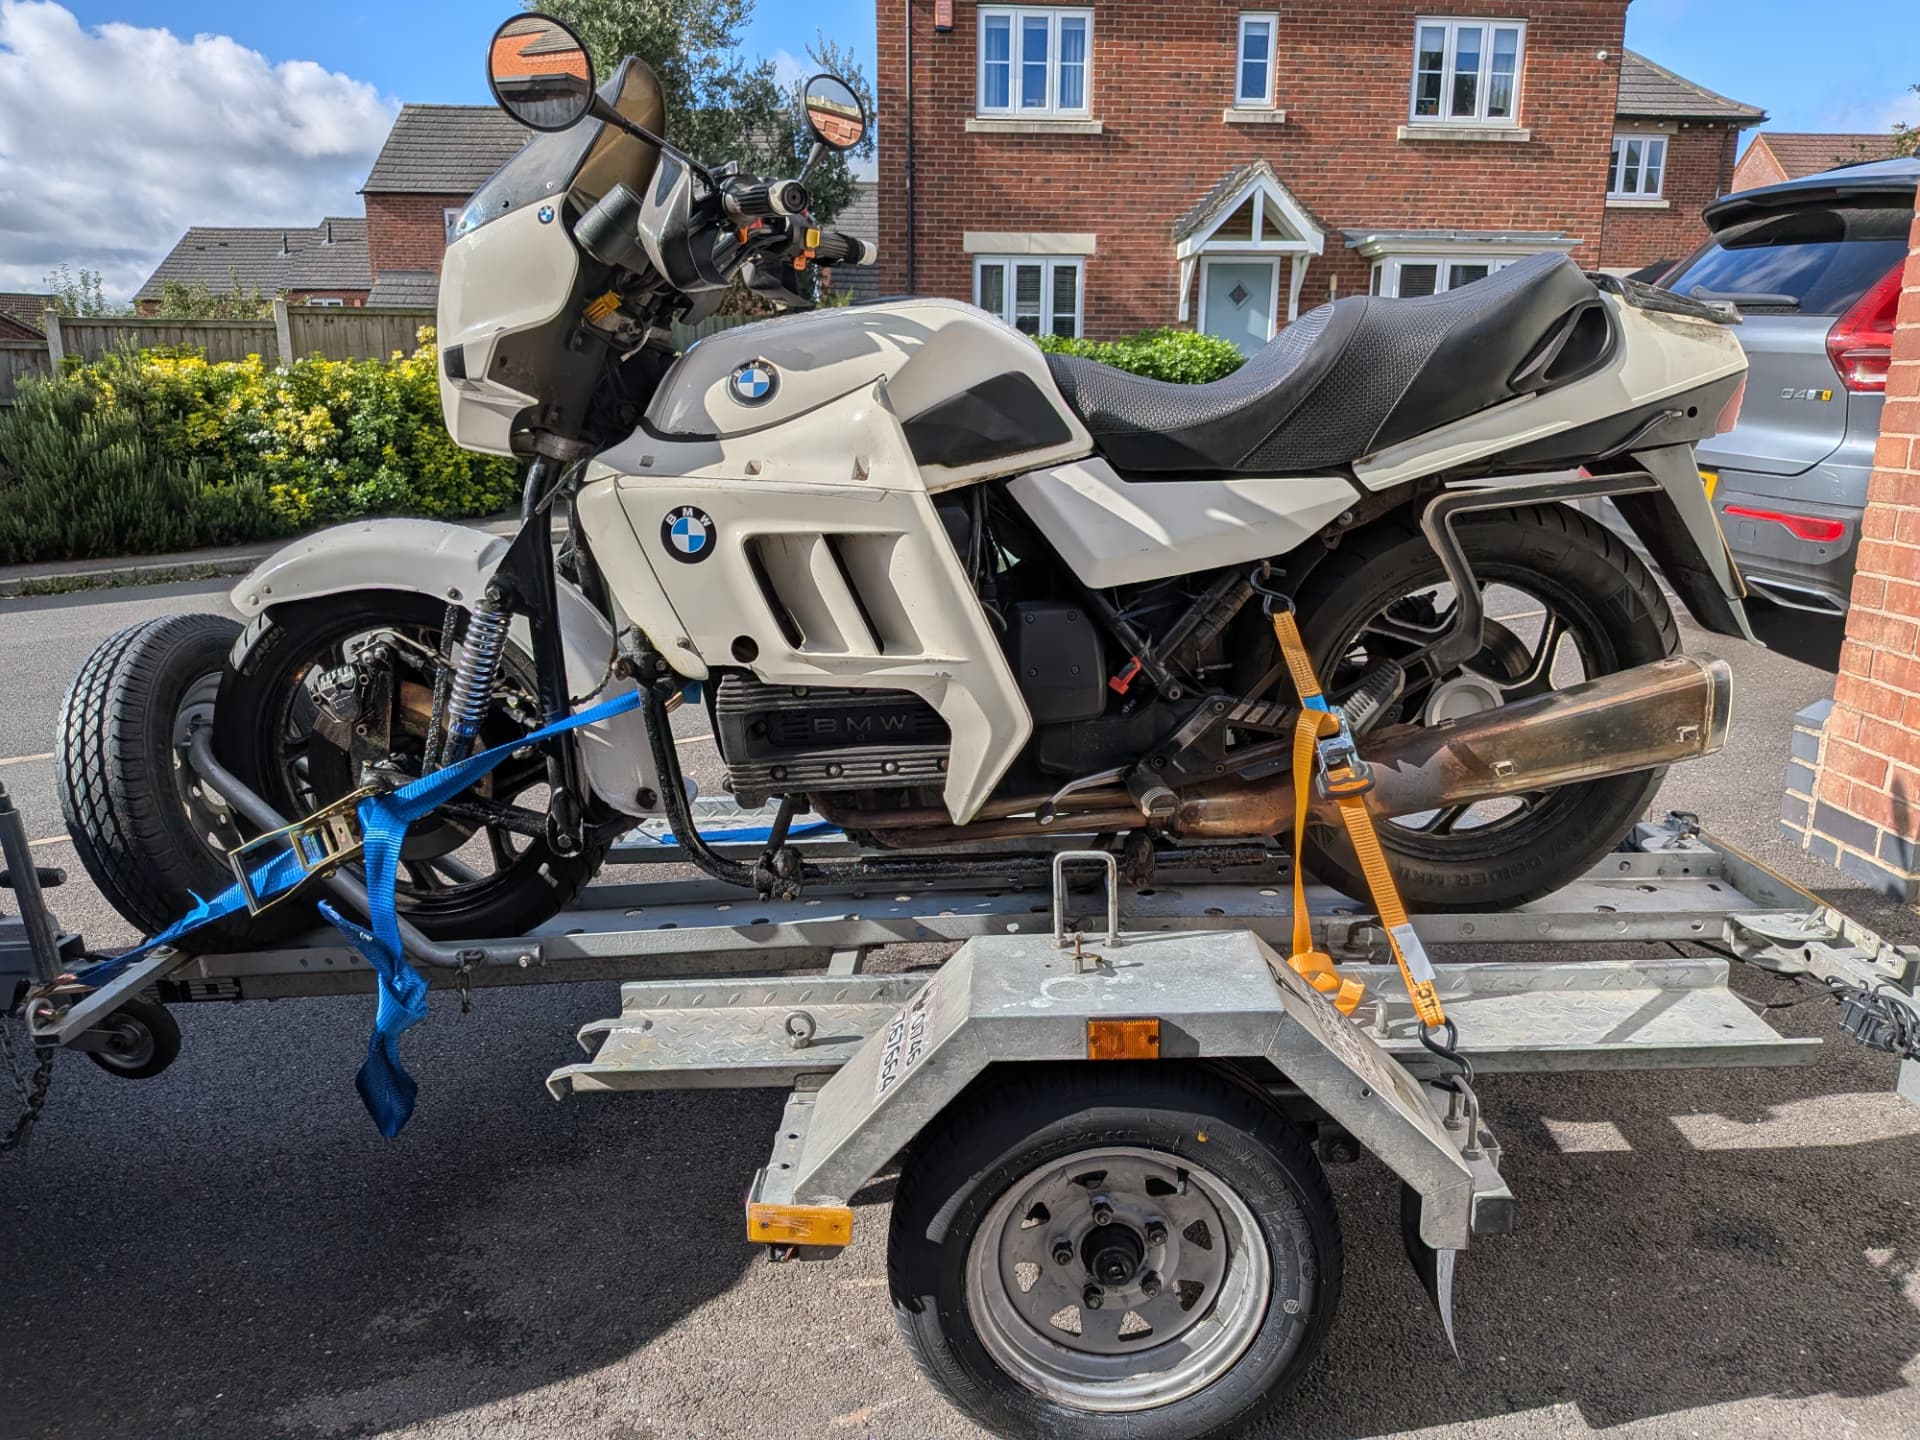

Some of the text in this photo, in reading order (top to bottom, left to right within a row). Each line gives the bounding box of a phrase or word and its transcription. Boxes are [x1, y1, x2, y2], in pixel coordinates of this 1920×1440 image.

[665, 507, 712, 527] BMW
[813, 714, 908, 735] BMW
[880, 1011, 906, 1093] 767664
